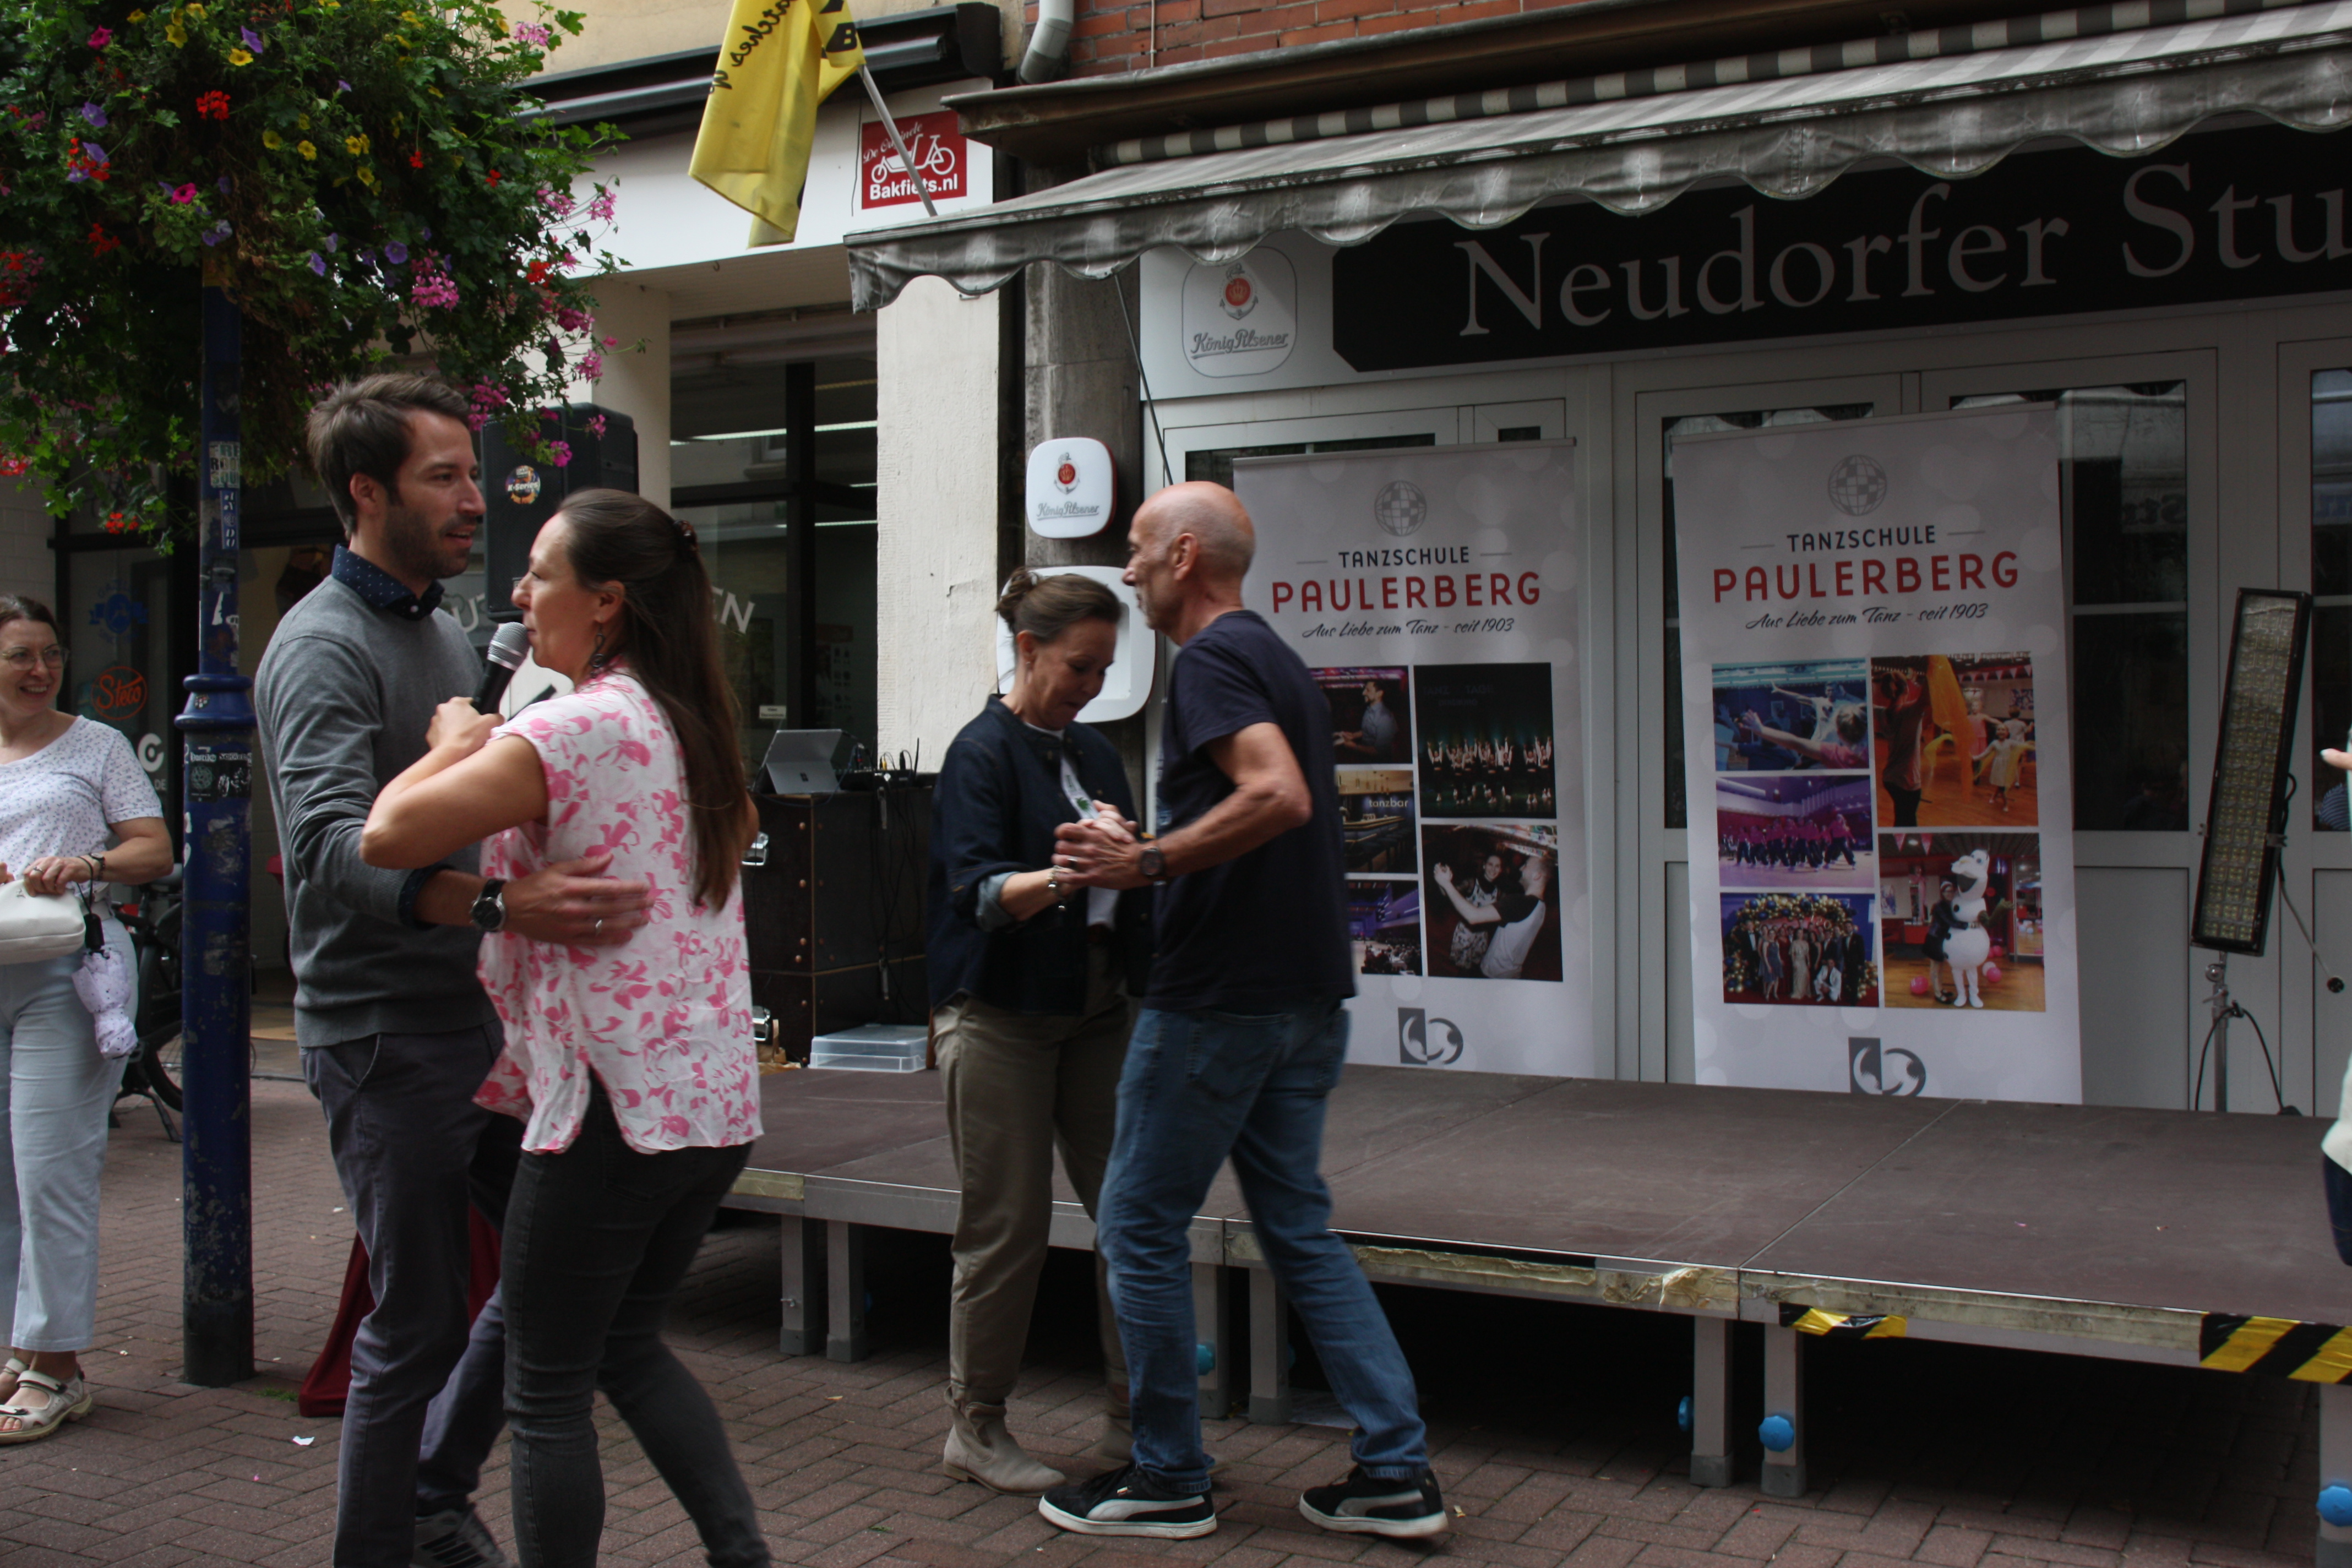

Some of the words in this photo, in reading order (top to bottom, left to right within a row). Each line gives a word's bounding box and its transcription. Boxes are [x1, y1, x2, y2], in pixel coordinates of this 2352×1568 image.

[1453, 182, 2069, 336] Neudorfer
[1191, 331, 1234, 353] König
[1233, 328, 1289, 349] Pilsener
[1036, 502, 1064, 518] König
[1787, 525, 1936, 552] TANZSCHULE
[1338, 546, 1471, 568] TANZSCHULE
[1713, 551, 2018, 603] PAULERBERG
[1272, 571, 1540, 614] PAULERBERG
[1302, 623, 1336, 639] Aus
[1338, 621, 1374, 638] Liebe
[1376, 625, 1402, 635] zum
[1406, 619, 1439, 635] Tanz
[1453, 619, 1480, 634] seit
[1480, 617, 1515, 633] 1903
[1745, 613, 1783, 630] Aus
[1785, 609, 1825, 628] Liebe
[1828, 613, 1857, 625] zum
[1862, 606, 1902, 623] Tanz
[1917, 605, 1948, 622] seit
[1949, 602, 1989, 620] 1903
[1369, 797, 1409, 808] tanzbar
